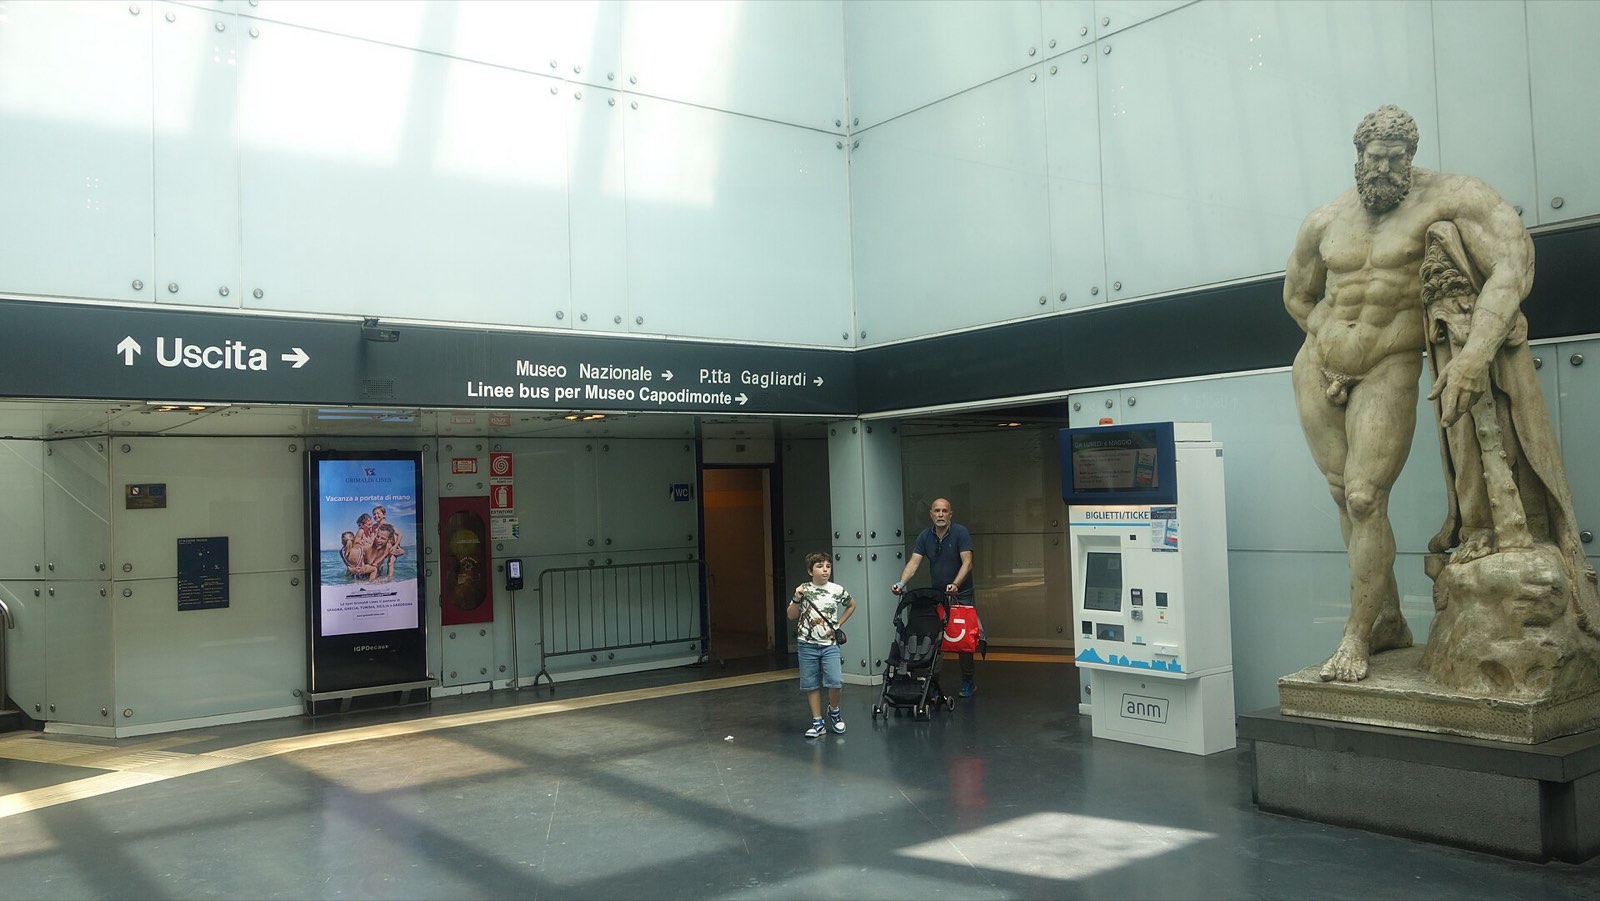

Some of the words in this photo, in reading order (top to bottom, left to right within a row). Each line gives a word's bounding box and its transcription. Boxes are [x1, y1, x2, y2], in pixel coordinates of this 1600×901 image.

[156, 336, 268, 371] Uscita
[516, 359, 567, 378] Museo
[579, 363, 653, 382] Nazionale
[699, 368, 731, 384] P.tta
[741, 370, 806, 389] Gagliardi
[467, 381, 515, 398] Linee
[519, 382, 550, 399] bus
[554, 387, 582, 403] per
[585, 384, 635, 401] Museo
[638, 386, 732, 405] Capodimonte
[359, 494, 384, 503] portata
[675, 488, 689, 497] WC
[1085, 511, 1150, 520] BIGLIETTI/TICKE
[353, 644, 389, 652] IGPDecaux
[1127, 701, 1161, 718] anm
